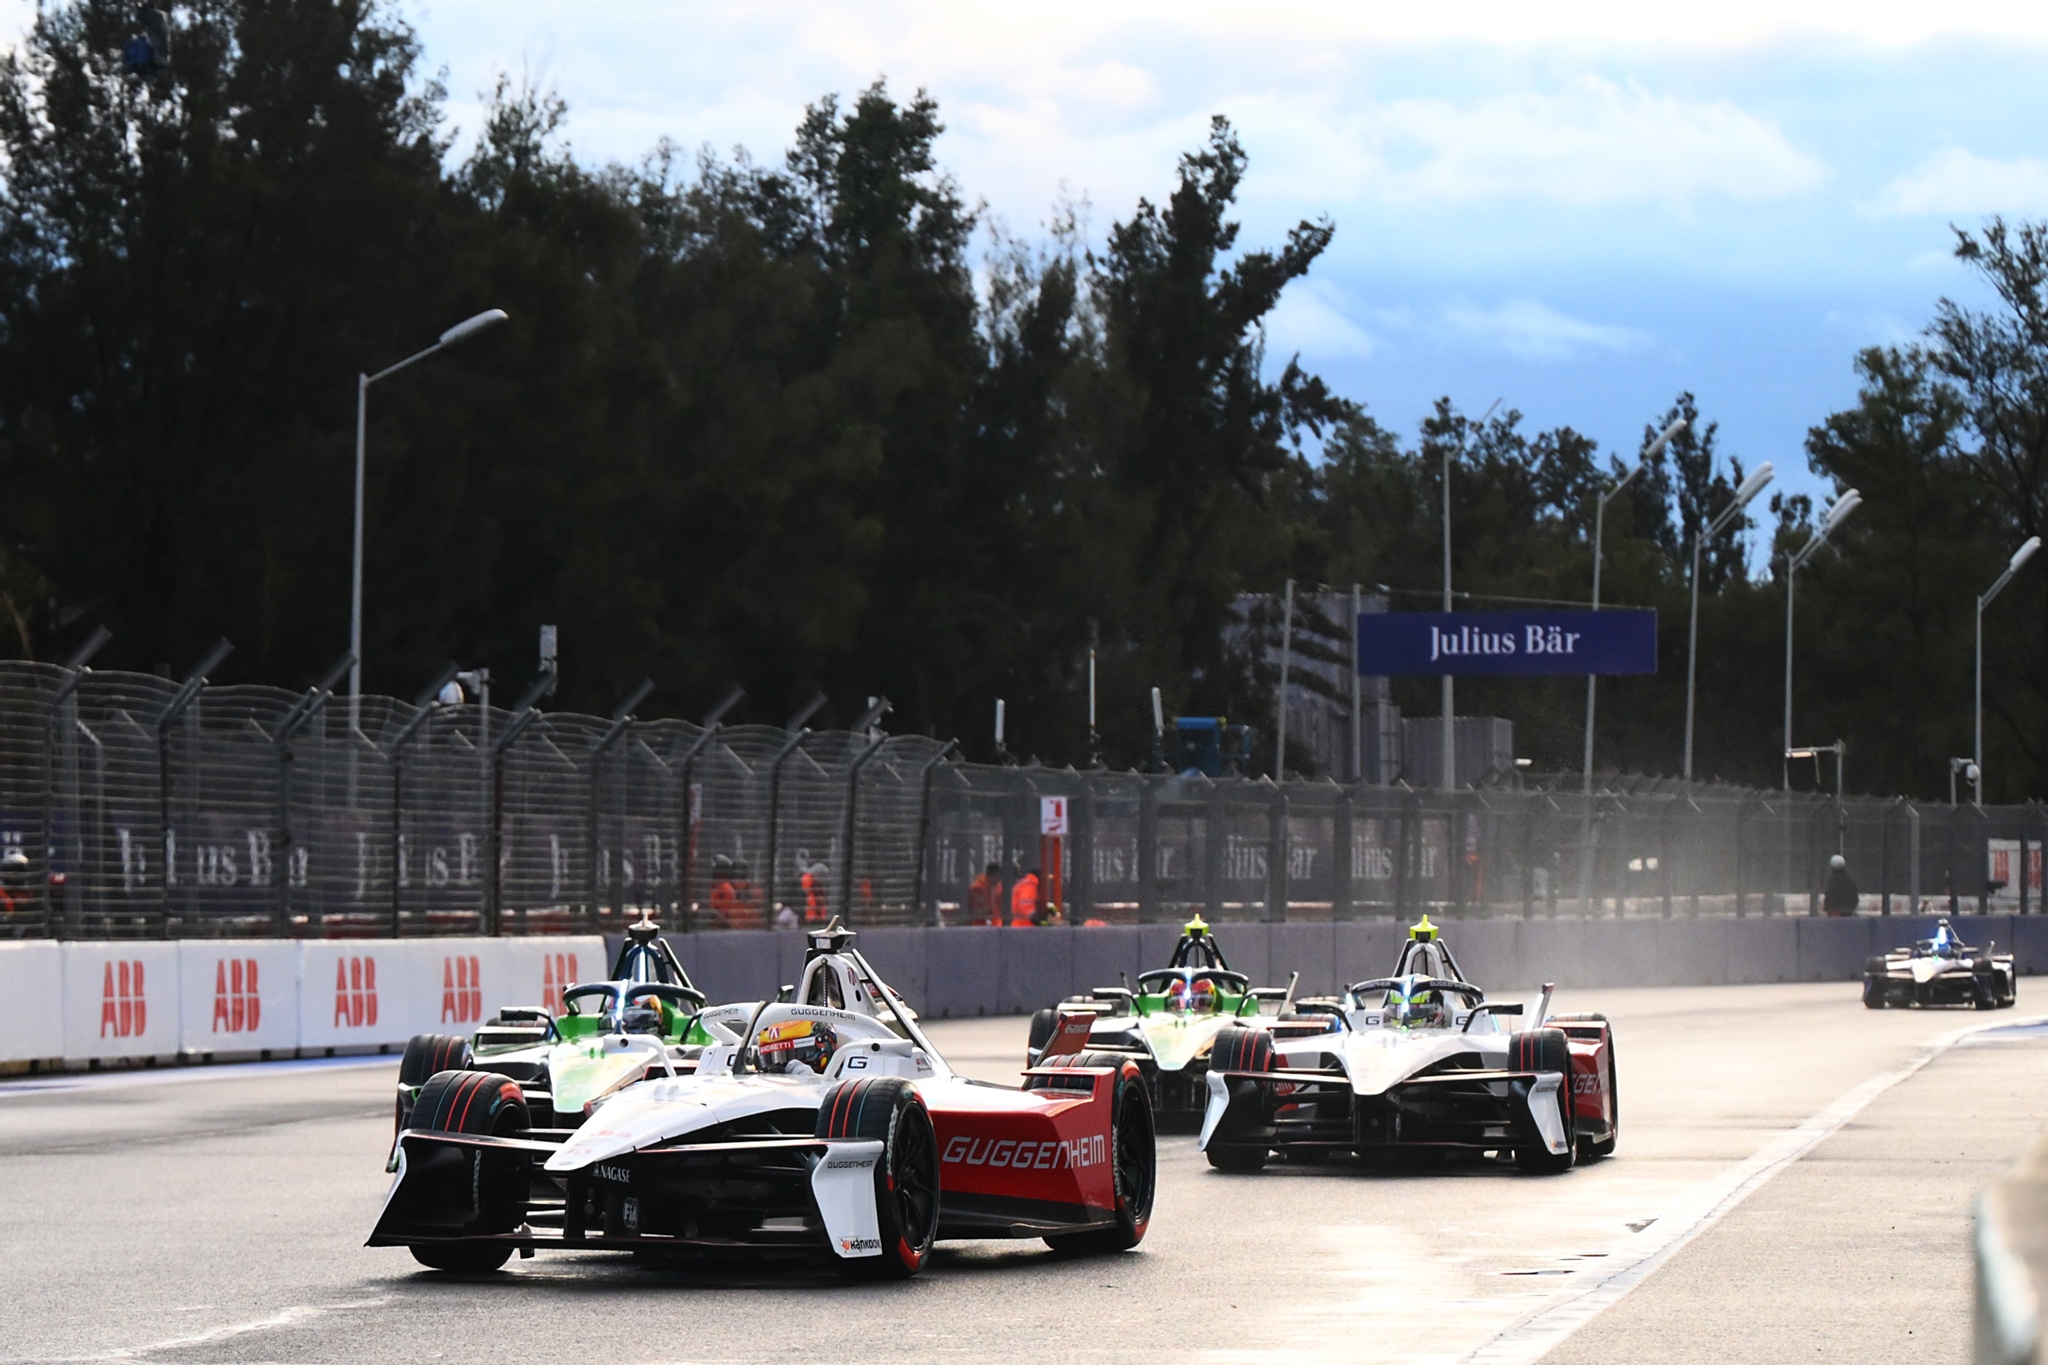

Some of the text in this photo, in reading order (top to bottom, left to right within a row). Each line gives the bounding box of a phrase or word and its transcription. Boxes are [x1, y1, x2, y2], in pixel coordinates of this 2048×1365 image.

[1431, 624, 1580, 661] Julius Bär
[101, 960, 146, 1037] ABB
[213, 958, 260, 1033] ABB
[334, 956, 377, 1027] ABB
[442, 955, 482, 1024] ABB
[791, 1008, 856, 1021] GUGGENHEIM
[1365, 1015, 1380, 1026] G
[760, 1041, 791, 1054] ANDRETTI
[848, 1056, 868, 1069] G
[827, 1159, 874, 1169] GUGGENHEIM
[942, 1134, 1106, 1169] GUGGENHEIM
[600, 1164, 631, 1183] NAGASE
